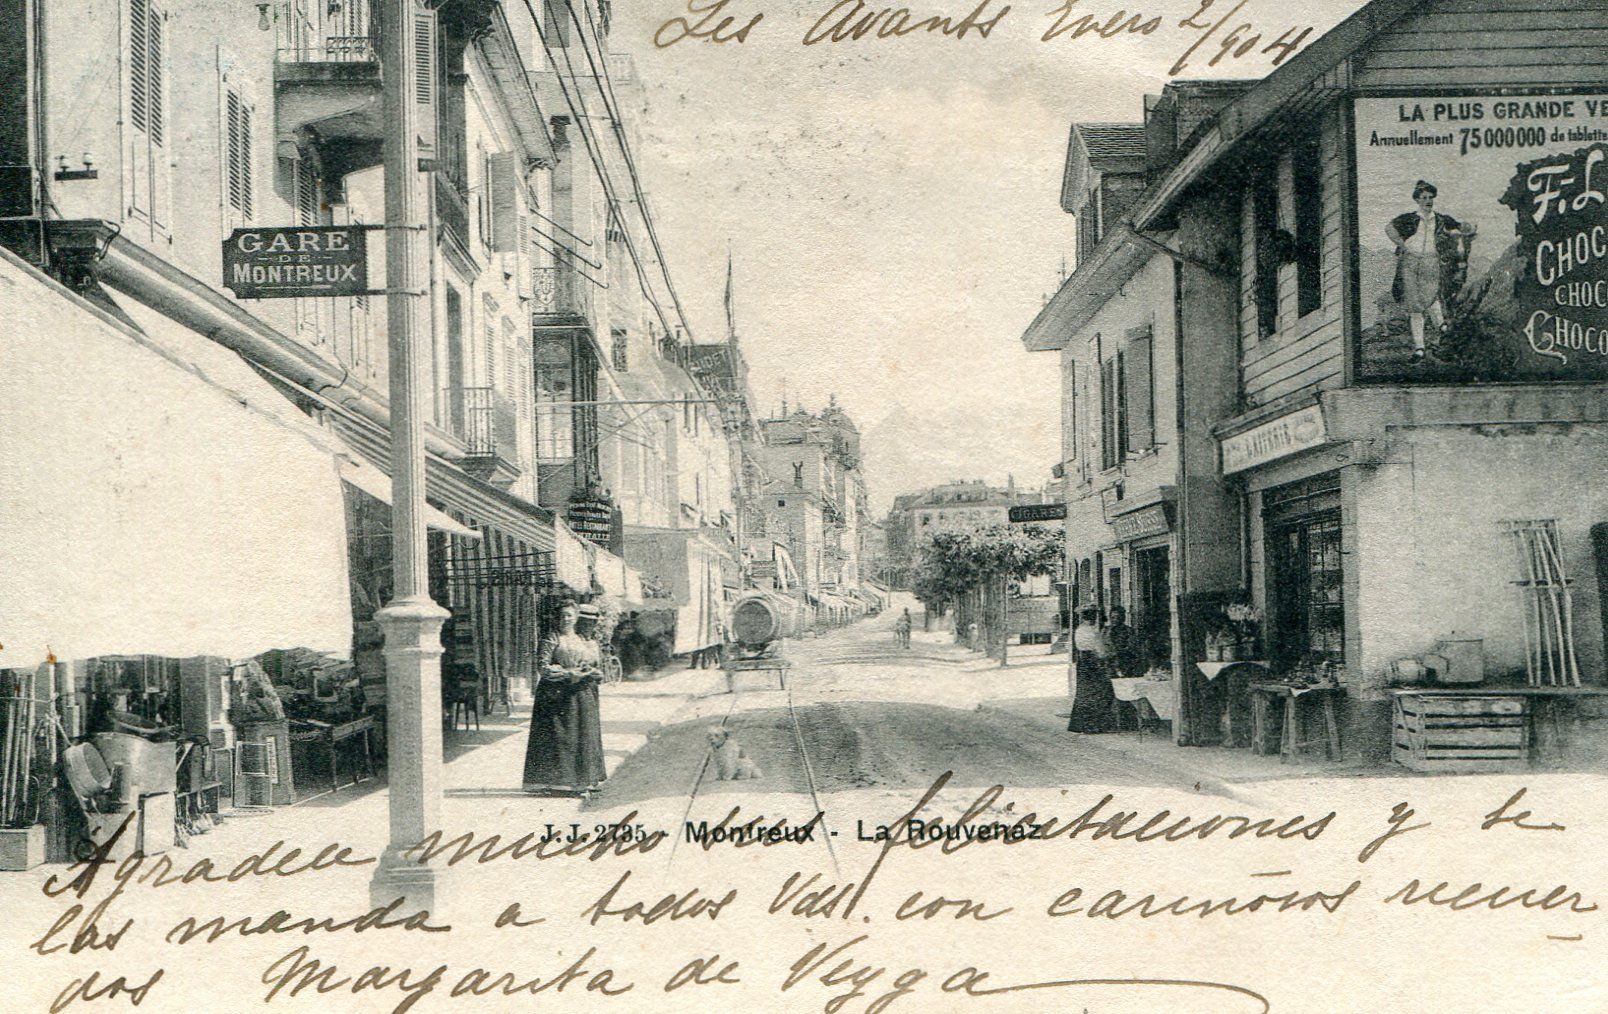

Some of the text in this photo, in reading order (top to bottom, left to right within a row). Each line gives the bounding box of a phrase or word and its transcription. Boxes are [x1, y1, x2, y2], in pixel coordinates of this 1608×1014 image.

[654, 0, 763, 48] Les
[1399, 104, 1425, 122] LA
[1434, 102, 1485, 121] PLUS
[1493, 100, 1576, 119] GRANDE
[1369, 130, 1454, 147] Annuellement
[1551, 126, 1565, 143] de
[237, 231, 350, 253] GARE
[279, 254, 312, 263] DE
[1536, 225, 1607, 286] CHOC
[233, 263, 358, 284] MONTREUX
[1555, 280, 1608, 308] CHOC
[1011, 506, 1066, 520] CIGARES
[1359, 801, 1431, 863] y
[494, 902, 546, 927] a
[580, 870, 738, 926] todos
[895, 890, 1014, 921] con
[664, 954, 741, 993] de
